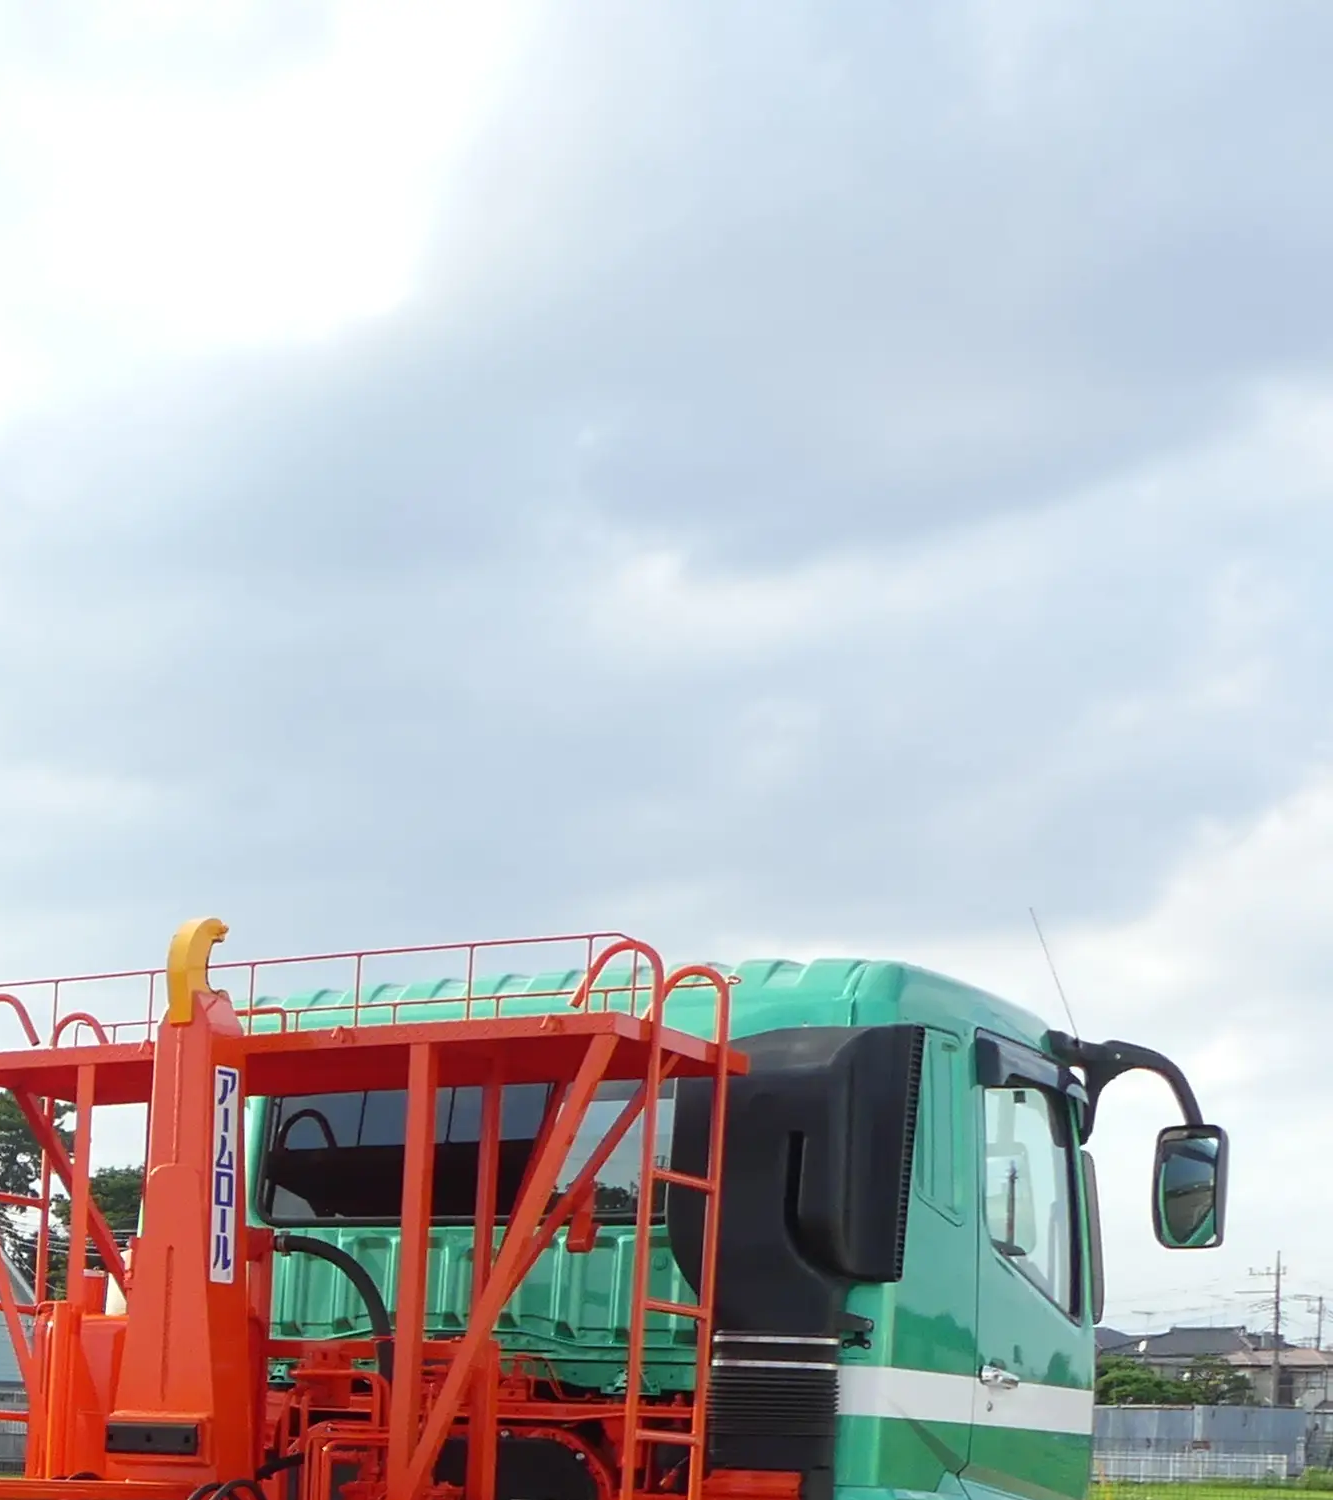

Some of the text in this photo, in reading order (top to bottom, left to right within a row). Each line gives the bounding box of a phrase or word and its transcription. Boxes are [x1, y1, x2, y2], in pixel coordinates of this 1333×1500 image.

[213, 1069, 237, 1270] アームロール
